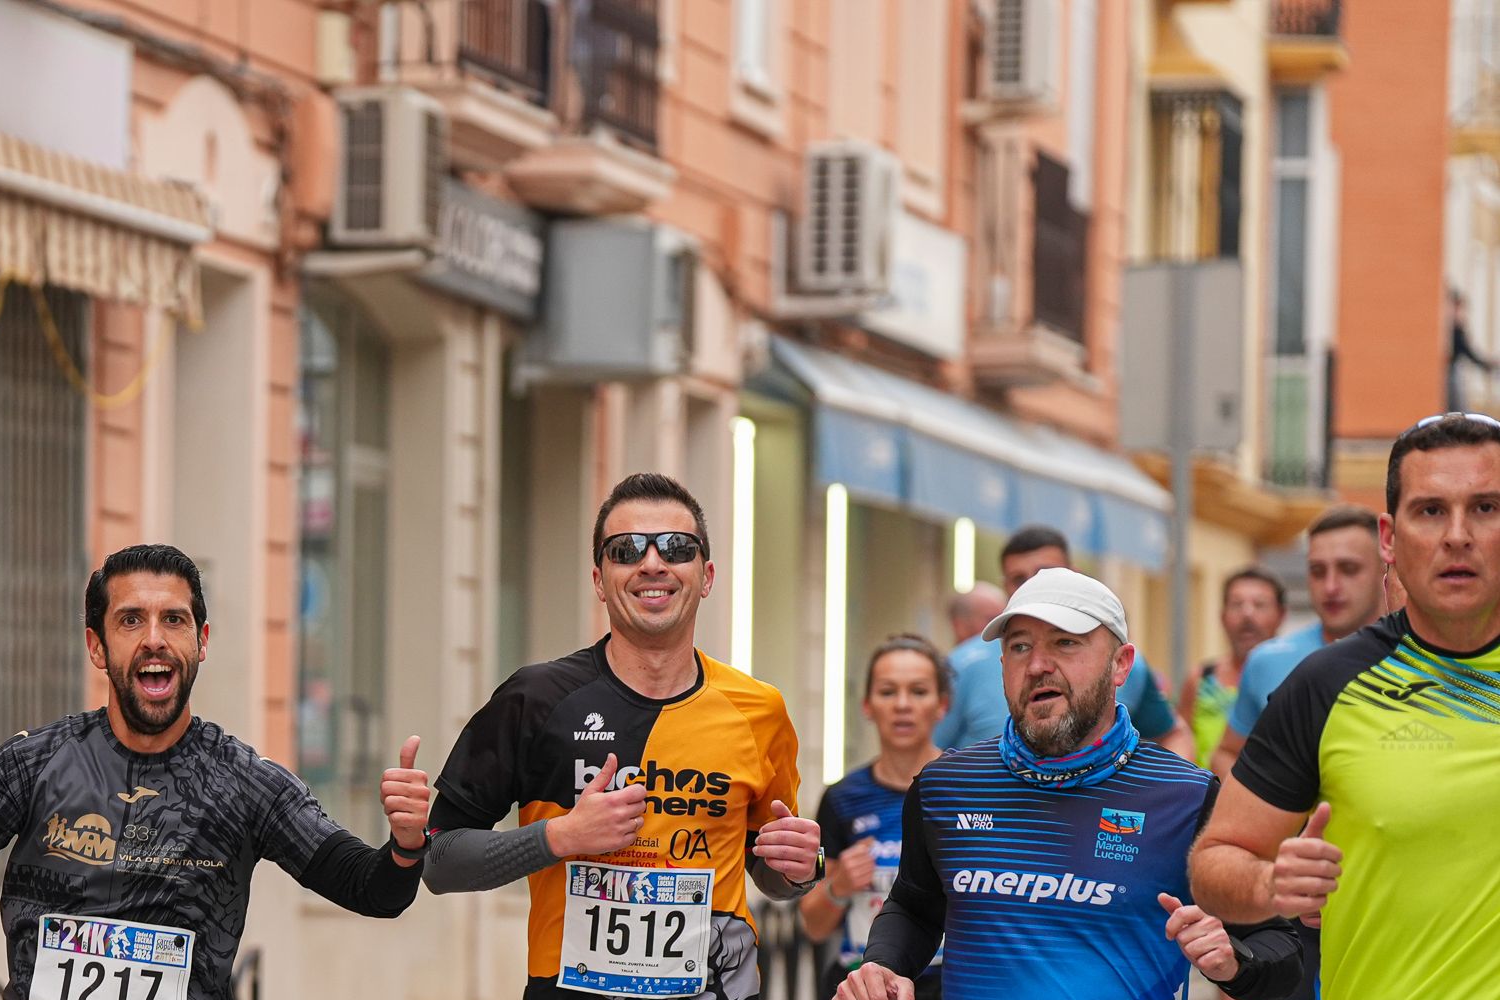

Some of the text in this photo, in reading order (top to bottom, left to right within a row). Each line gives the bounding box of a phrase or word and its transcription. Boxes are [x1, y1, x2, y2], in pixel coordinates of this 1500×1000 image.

[573, 731, 615, 741] VIATOR
[971, 813, 993, 822] RUN
[972, 821, 994, 830] PRO
[1097, 832, 1122, 843] Club
[1095, 840, 1139, 855] Maratón
[118, 854, 142, 863] VILA
[145, 856, 160, 864] DE
[162, 857, 194, 867] SANTA
[196, 859, 224, 868] POLA
[1094, 849, 1134, 862] Lucena
[656, 892, 674, 902] 2026
[585, 904, 686, 958] 1512
[60, 920, 108, 956] 21K
[132, 948, 151, 960] 2026
